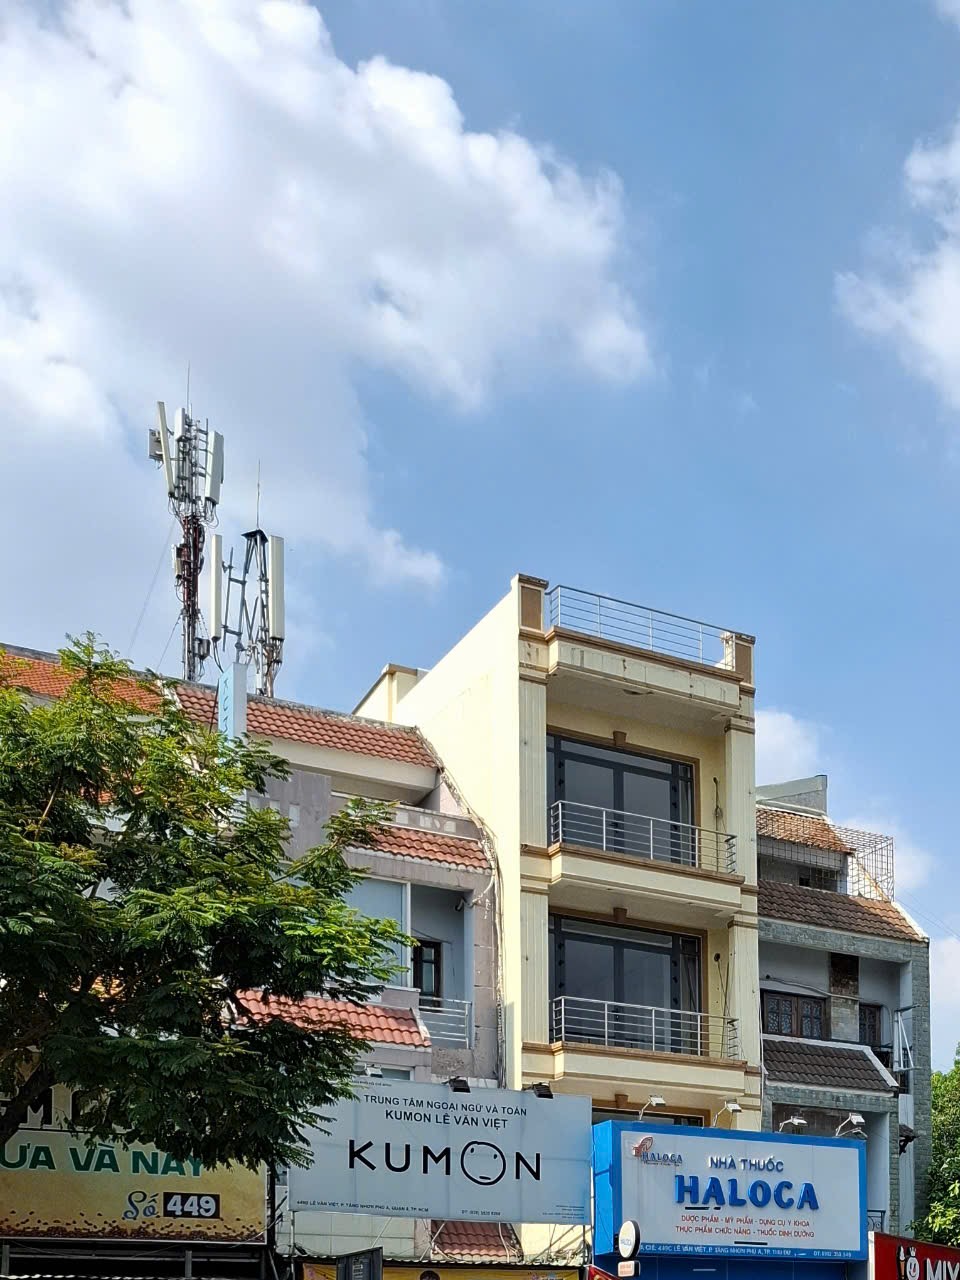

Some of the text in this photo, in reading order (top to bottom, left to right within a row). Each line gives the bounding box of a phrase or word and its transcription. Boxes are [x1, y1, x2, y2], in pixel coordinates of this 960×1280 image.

[364, 1095, 527, 1116] TRUNG TÂM NGOẠI NGỮ VÀ TOÁN
[385, 1110, 508, 1130] KUMON LÊ VĂN VIỆT
[69, 1143, 120, 1173] VÀ
[132, 1151, 202, 1177] NAY
[349, 1140, 541, 1186] KUMON
[642, 1151, 682, 1163] HALOCA
[708, 1155, 784, 1172] NHÀ THUỐC
[675, 1174, 819, 1210] HALOCA
[123, 1190, 217, 1220] Số 449
